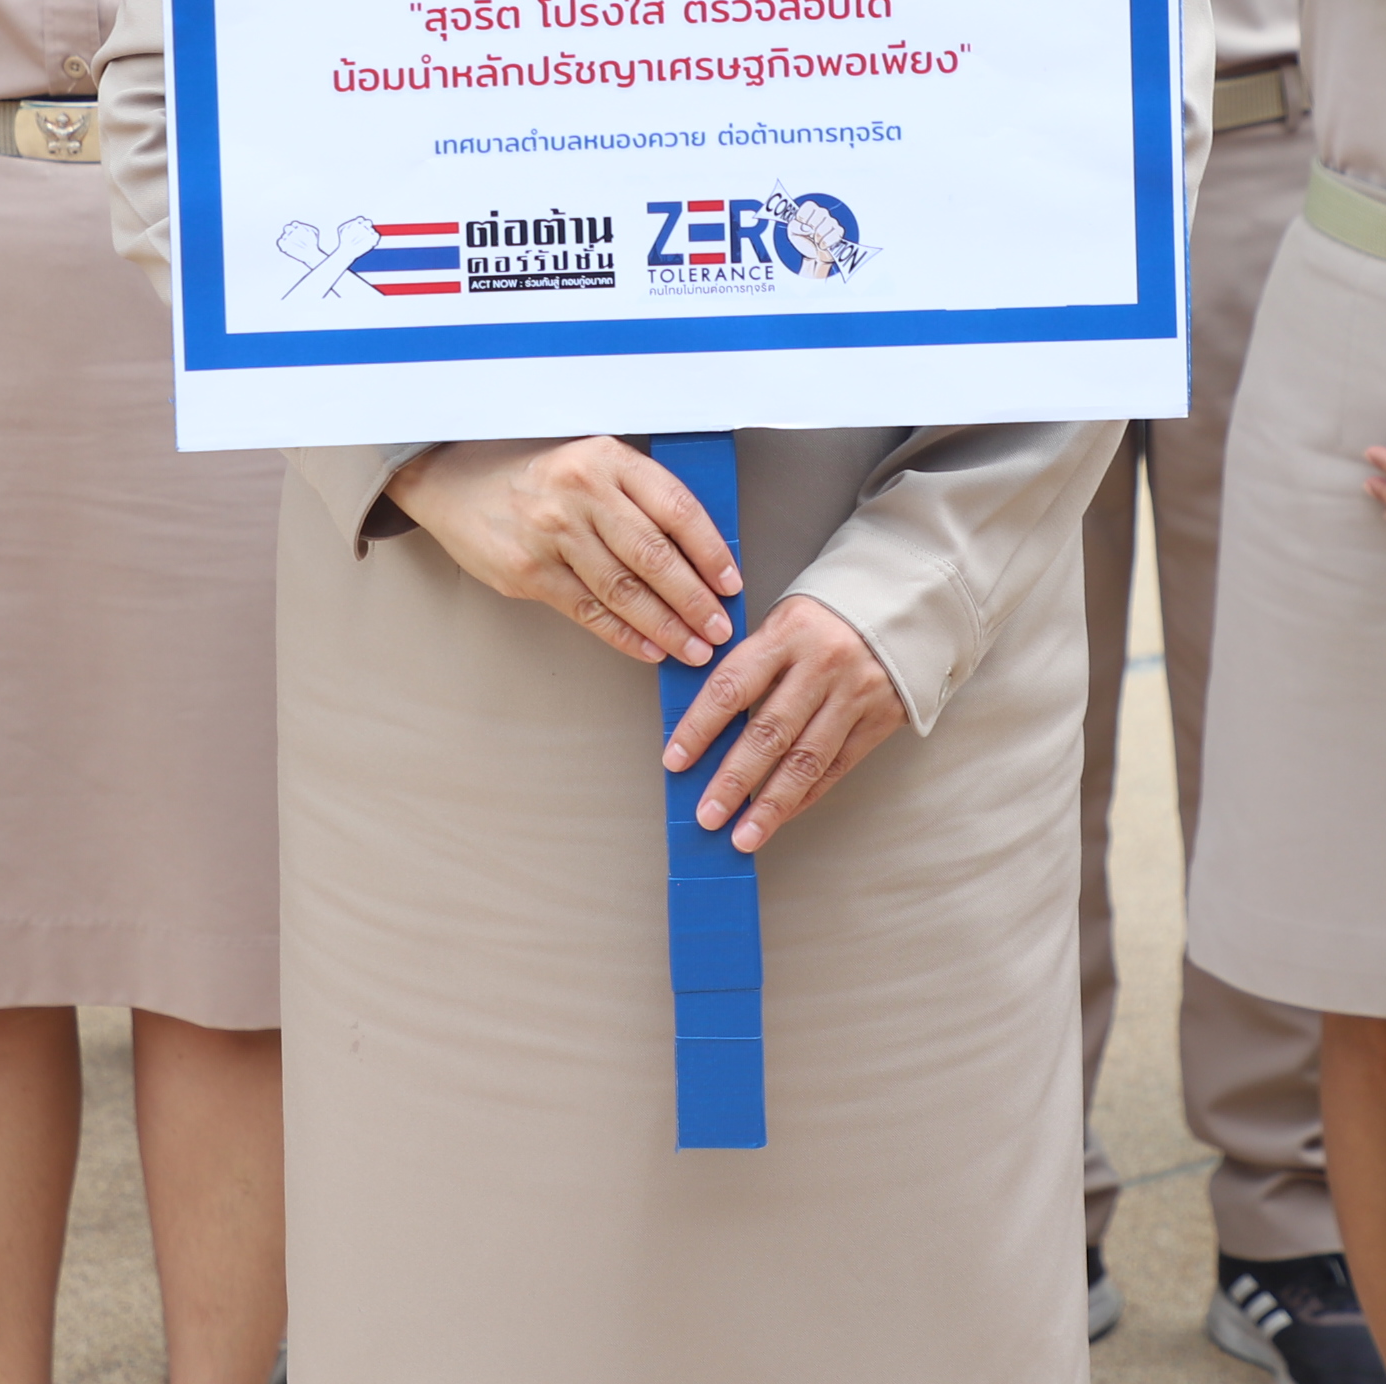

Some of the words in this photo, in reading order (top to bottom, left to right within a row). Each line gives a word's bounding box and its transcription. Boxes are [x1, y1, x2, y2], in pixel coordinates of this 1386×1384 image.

[410, 0, 521, 41] "สุจริต
[333, 41, 971, 92] น้อมนำหลักปรัชญาเศรษฐกิจพอเพียง"
[435, 128, 706, 155] เทศบาลตำบลหนองควาย
[718, 121, 902, 149] ต่อต้านการทุจริต
[466, 208, 614, 248] ต่อต้าน
[647, 193, 860, 279] ZERO
[467, 244, 614, 274] คอร์รัปชั่น
[647, 266, 774, 283] TOLERANCE
[471, 280, 491, 290] ACT
[493, 279, 518, 289] NOW
